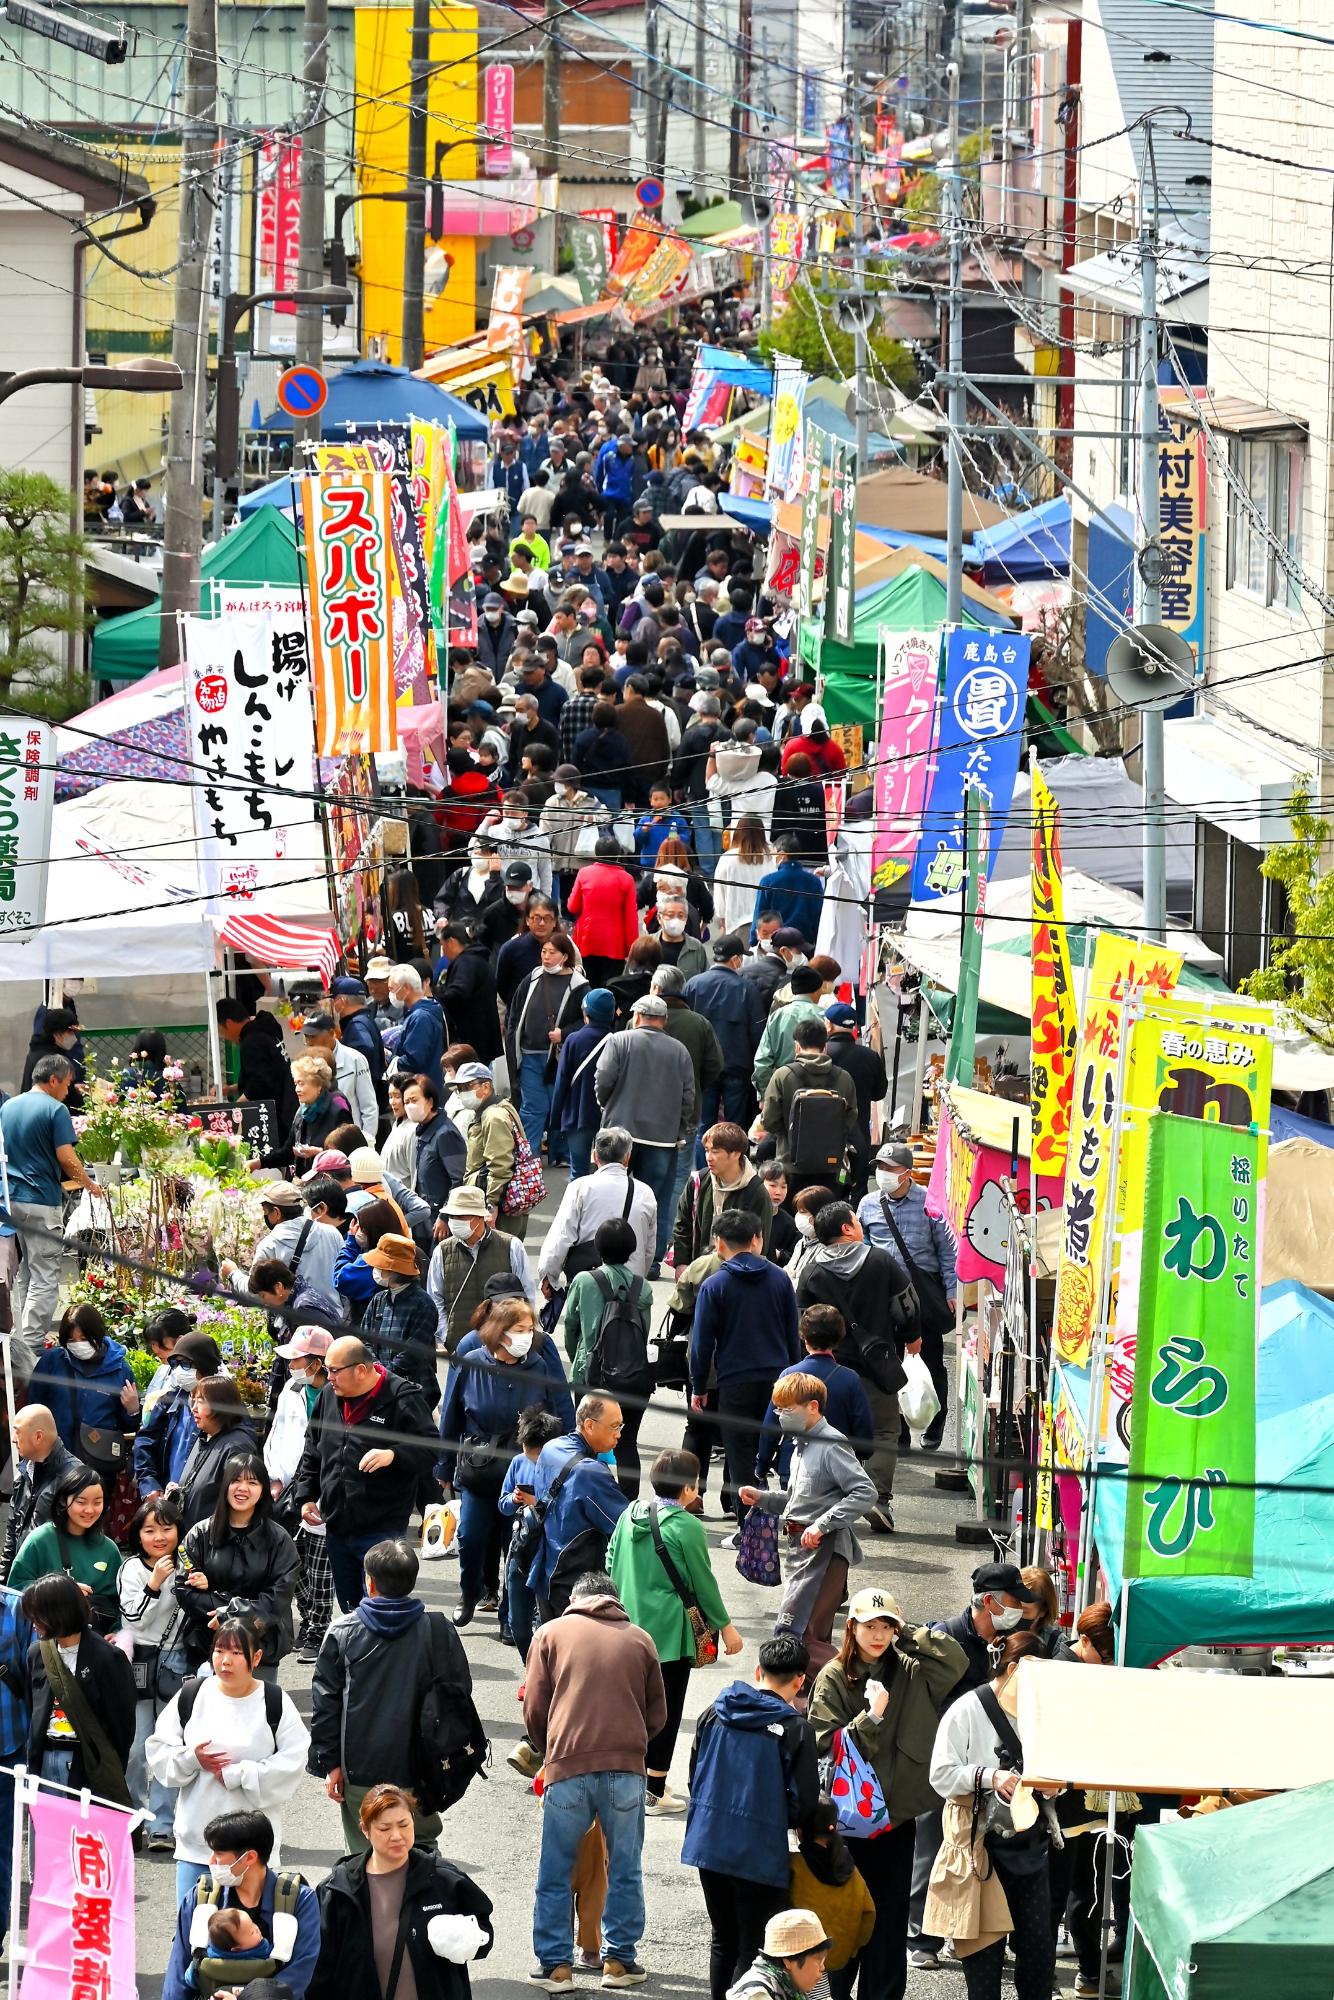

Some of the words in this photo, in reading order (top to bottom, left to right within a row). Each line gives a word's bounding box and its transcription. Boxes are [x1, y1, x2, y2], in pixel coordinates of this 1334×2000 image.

[225, 602, 308, 613] がんばろう宮城
[322, 487, 381, 703] スパボー
[963, 641, 1017, 664] 鹿島台
[272, 631, 307, 702] 揚げ
[24, 730, 41, 801] 保険調剤
[198, 723, 237, 846] やきもち
[234, 649, 272, 830] しんこもち
[887, 694, 929, 853] クレープ
[1160, 1031, 1257, 1067] 春の恵み
[1065, 1064, 1115, 1264] いも煮
[1231, 1155, 1252, 1298] 採りたて
[1144, 1196, 1229, 1559] わらび
